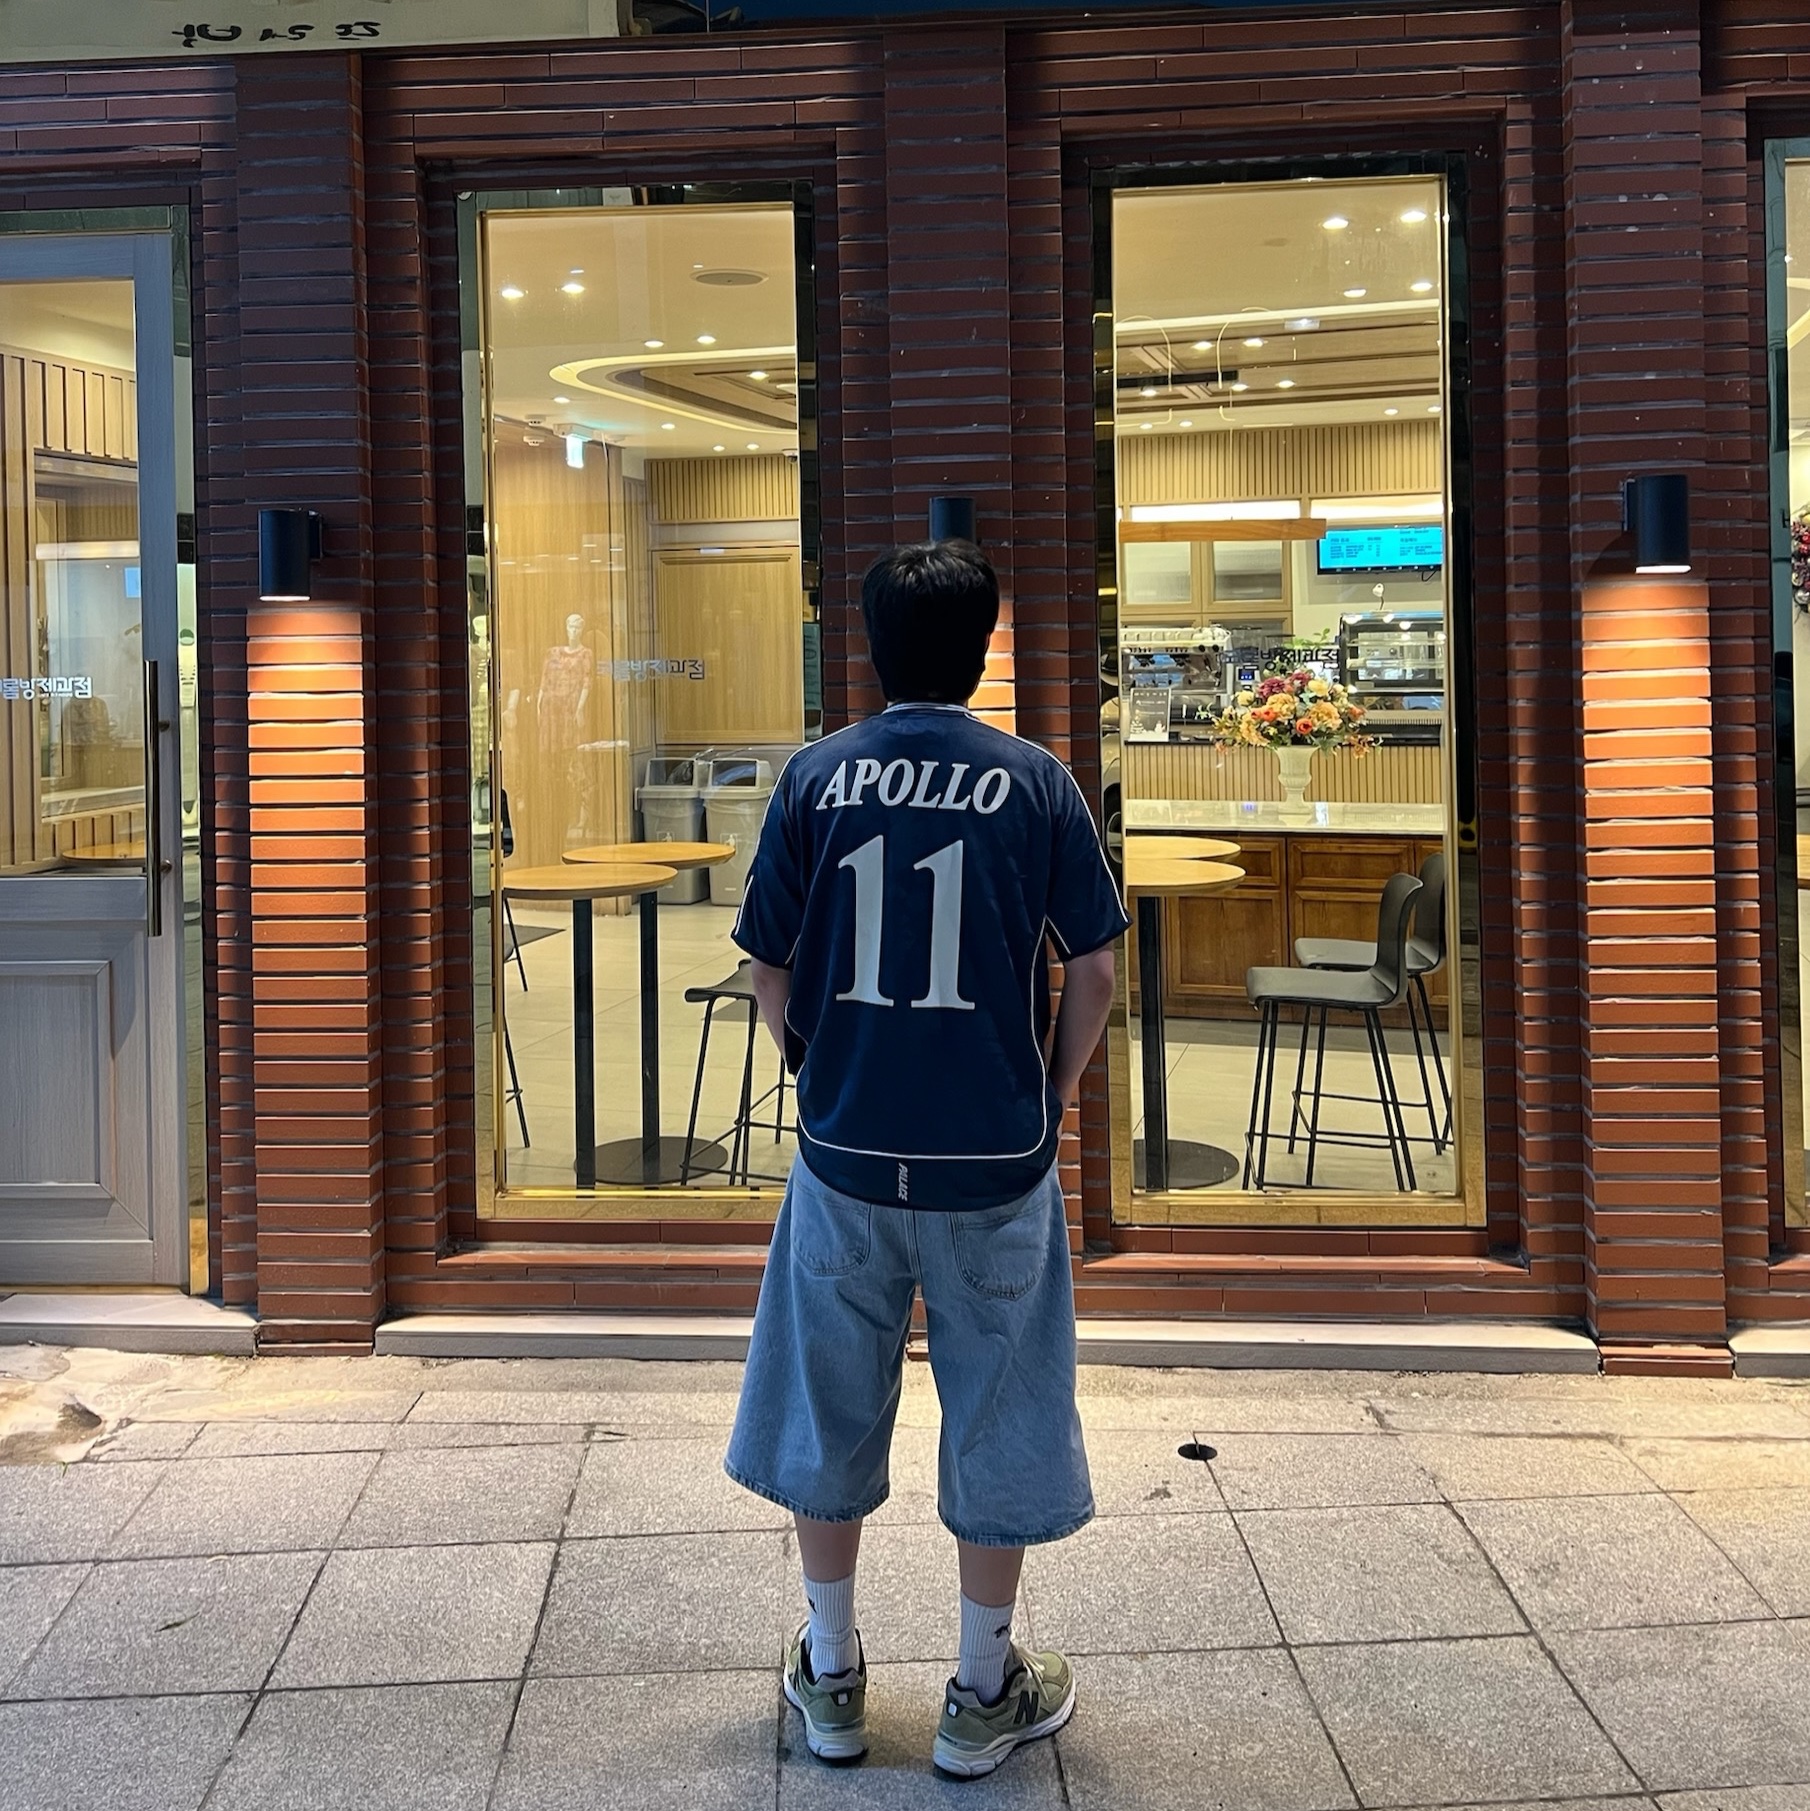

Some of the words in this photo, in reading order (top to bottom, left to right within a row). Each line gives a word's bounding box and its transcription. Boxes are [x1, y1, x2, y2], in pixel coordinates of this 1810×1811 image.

[0, 676, 92, 700] 롬방제과점
[816, 758, 1011, 815] APOLLO
[835, 834, 976, 1011] 11
[1013, 1690, 1039, 1725] N
